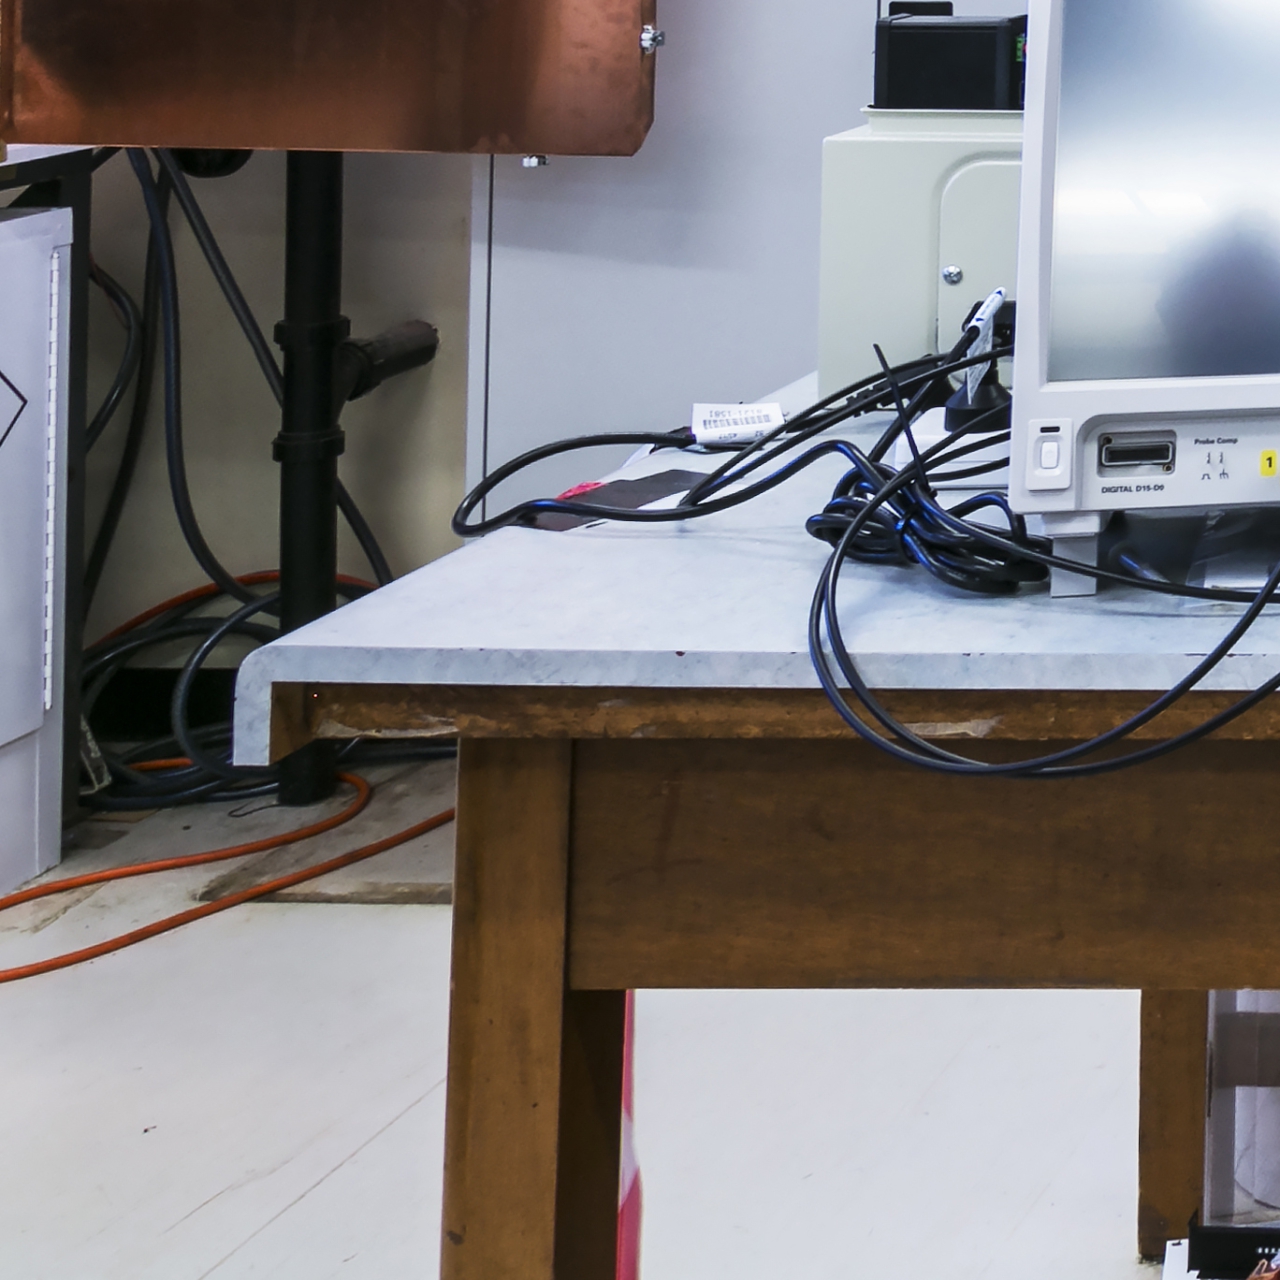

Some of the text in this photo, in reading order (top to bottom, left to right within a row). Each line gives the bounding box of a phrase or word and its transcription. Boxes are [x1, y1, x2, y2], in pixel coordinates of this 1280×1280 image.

[1216, 436, 1238, 445] Comp
[1265, 456, 1273, 468] 1
[1101, 484, 1165, 494] DIGITAL D15-D0
